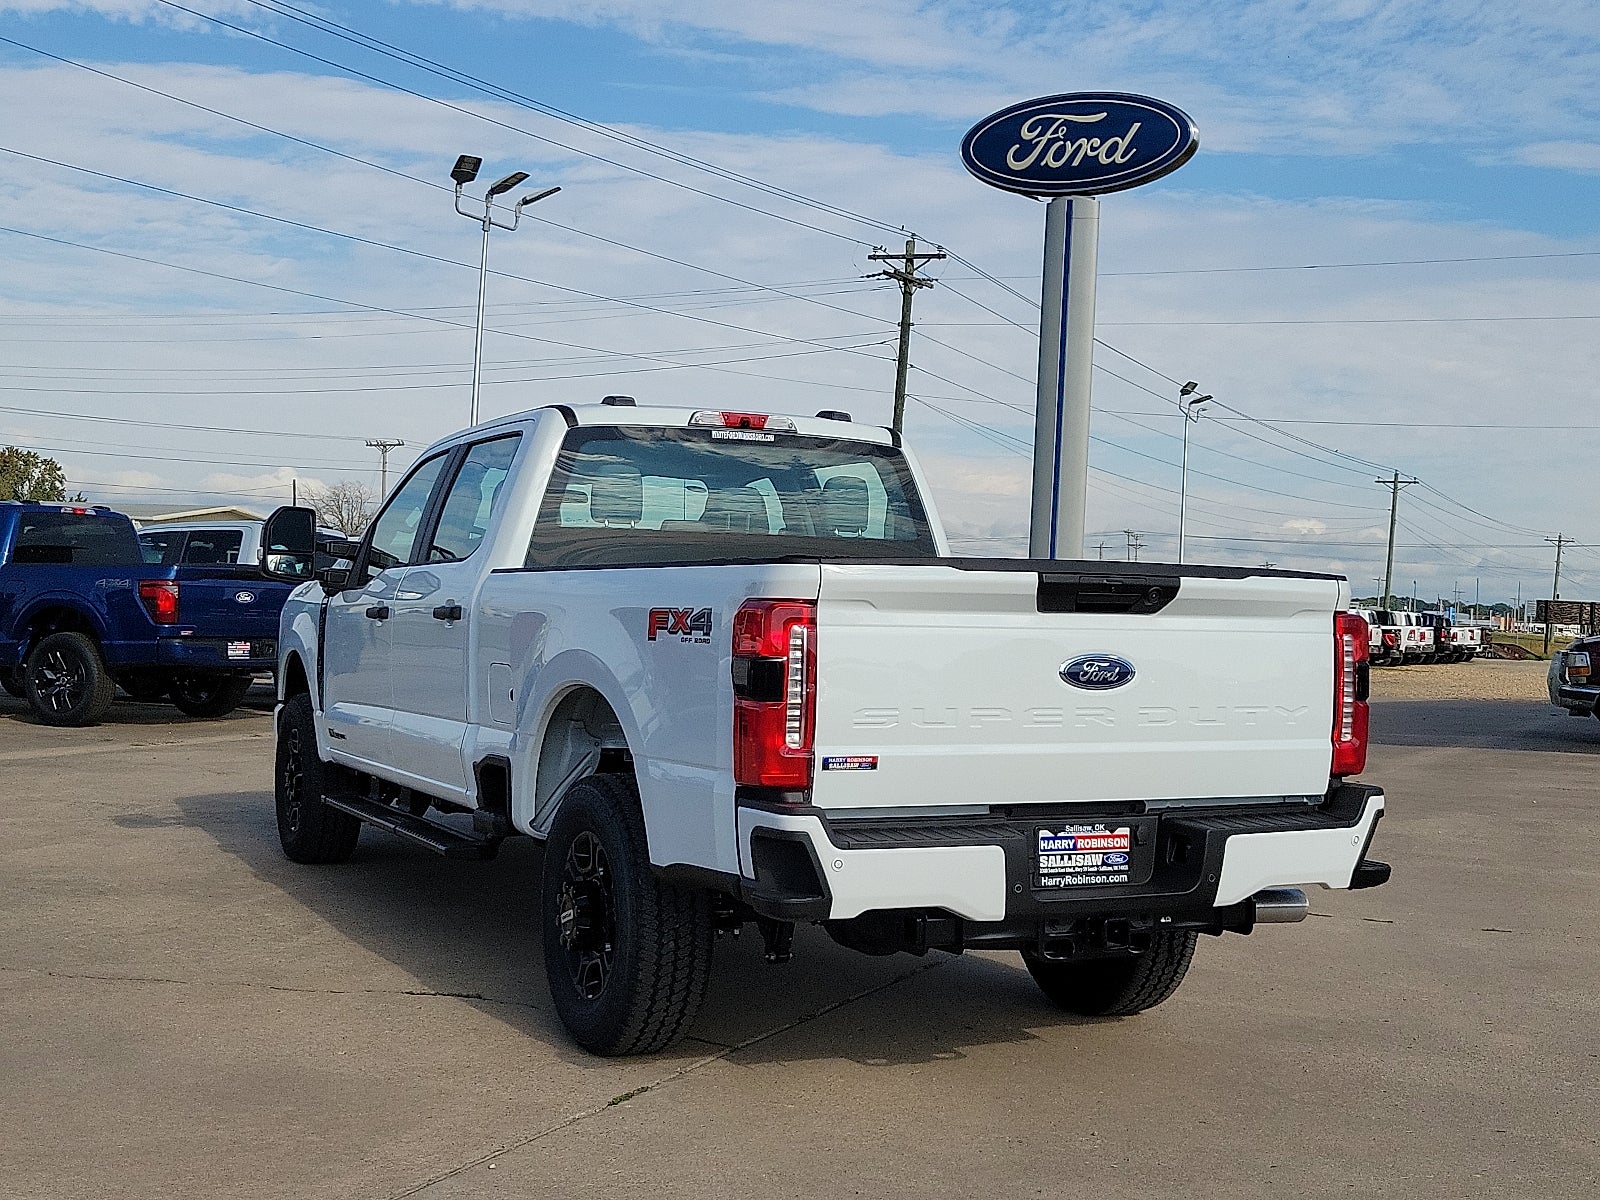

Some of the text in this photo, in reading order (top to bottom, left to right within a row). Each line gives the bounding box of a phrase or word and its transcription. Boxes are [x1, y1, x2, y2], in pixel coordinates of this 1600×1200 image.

[1006, 112, 1142, 170] Ford
[648, 608, 712, 641] FX4
[1080, 661, 1120, 681] Ford
[852, 705, 1309, 728] SUPER DUTY
[1040, 838, 1128, 850] HARRY ROBINSON
[1040, 853, 1103, 868] SALLISAW
[1041, 875, 1128, 887] HarryRobinson.com
